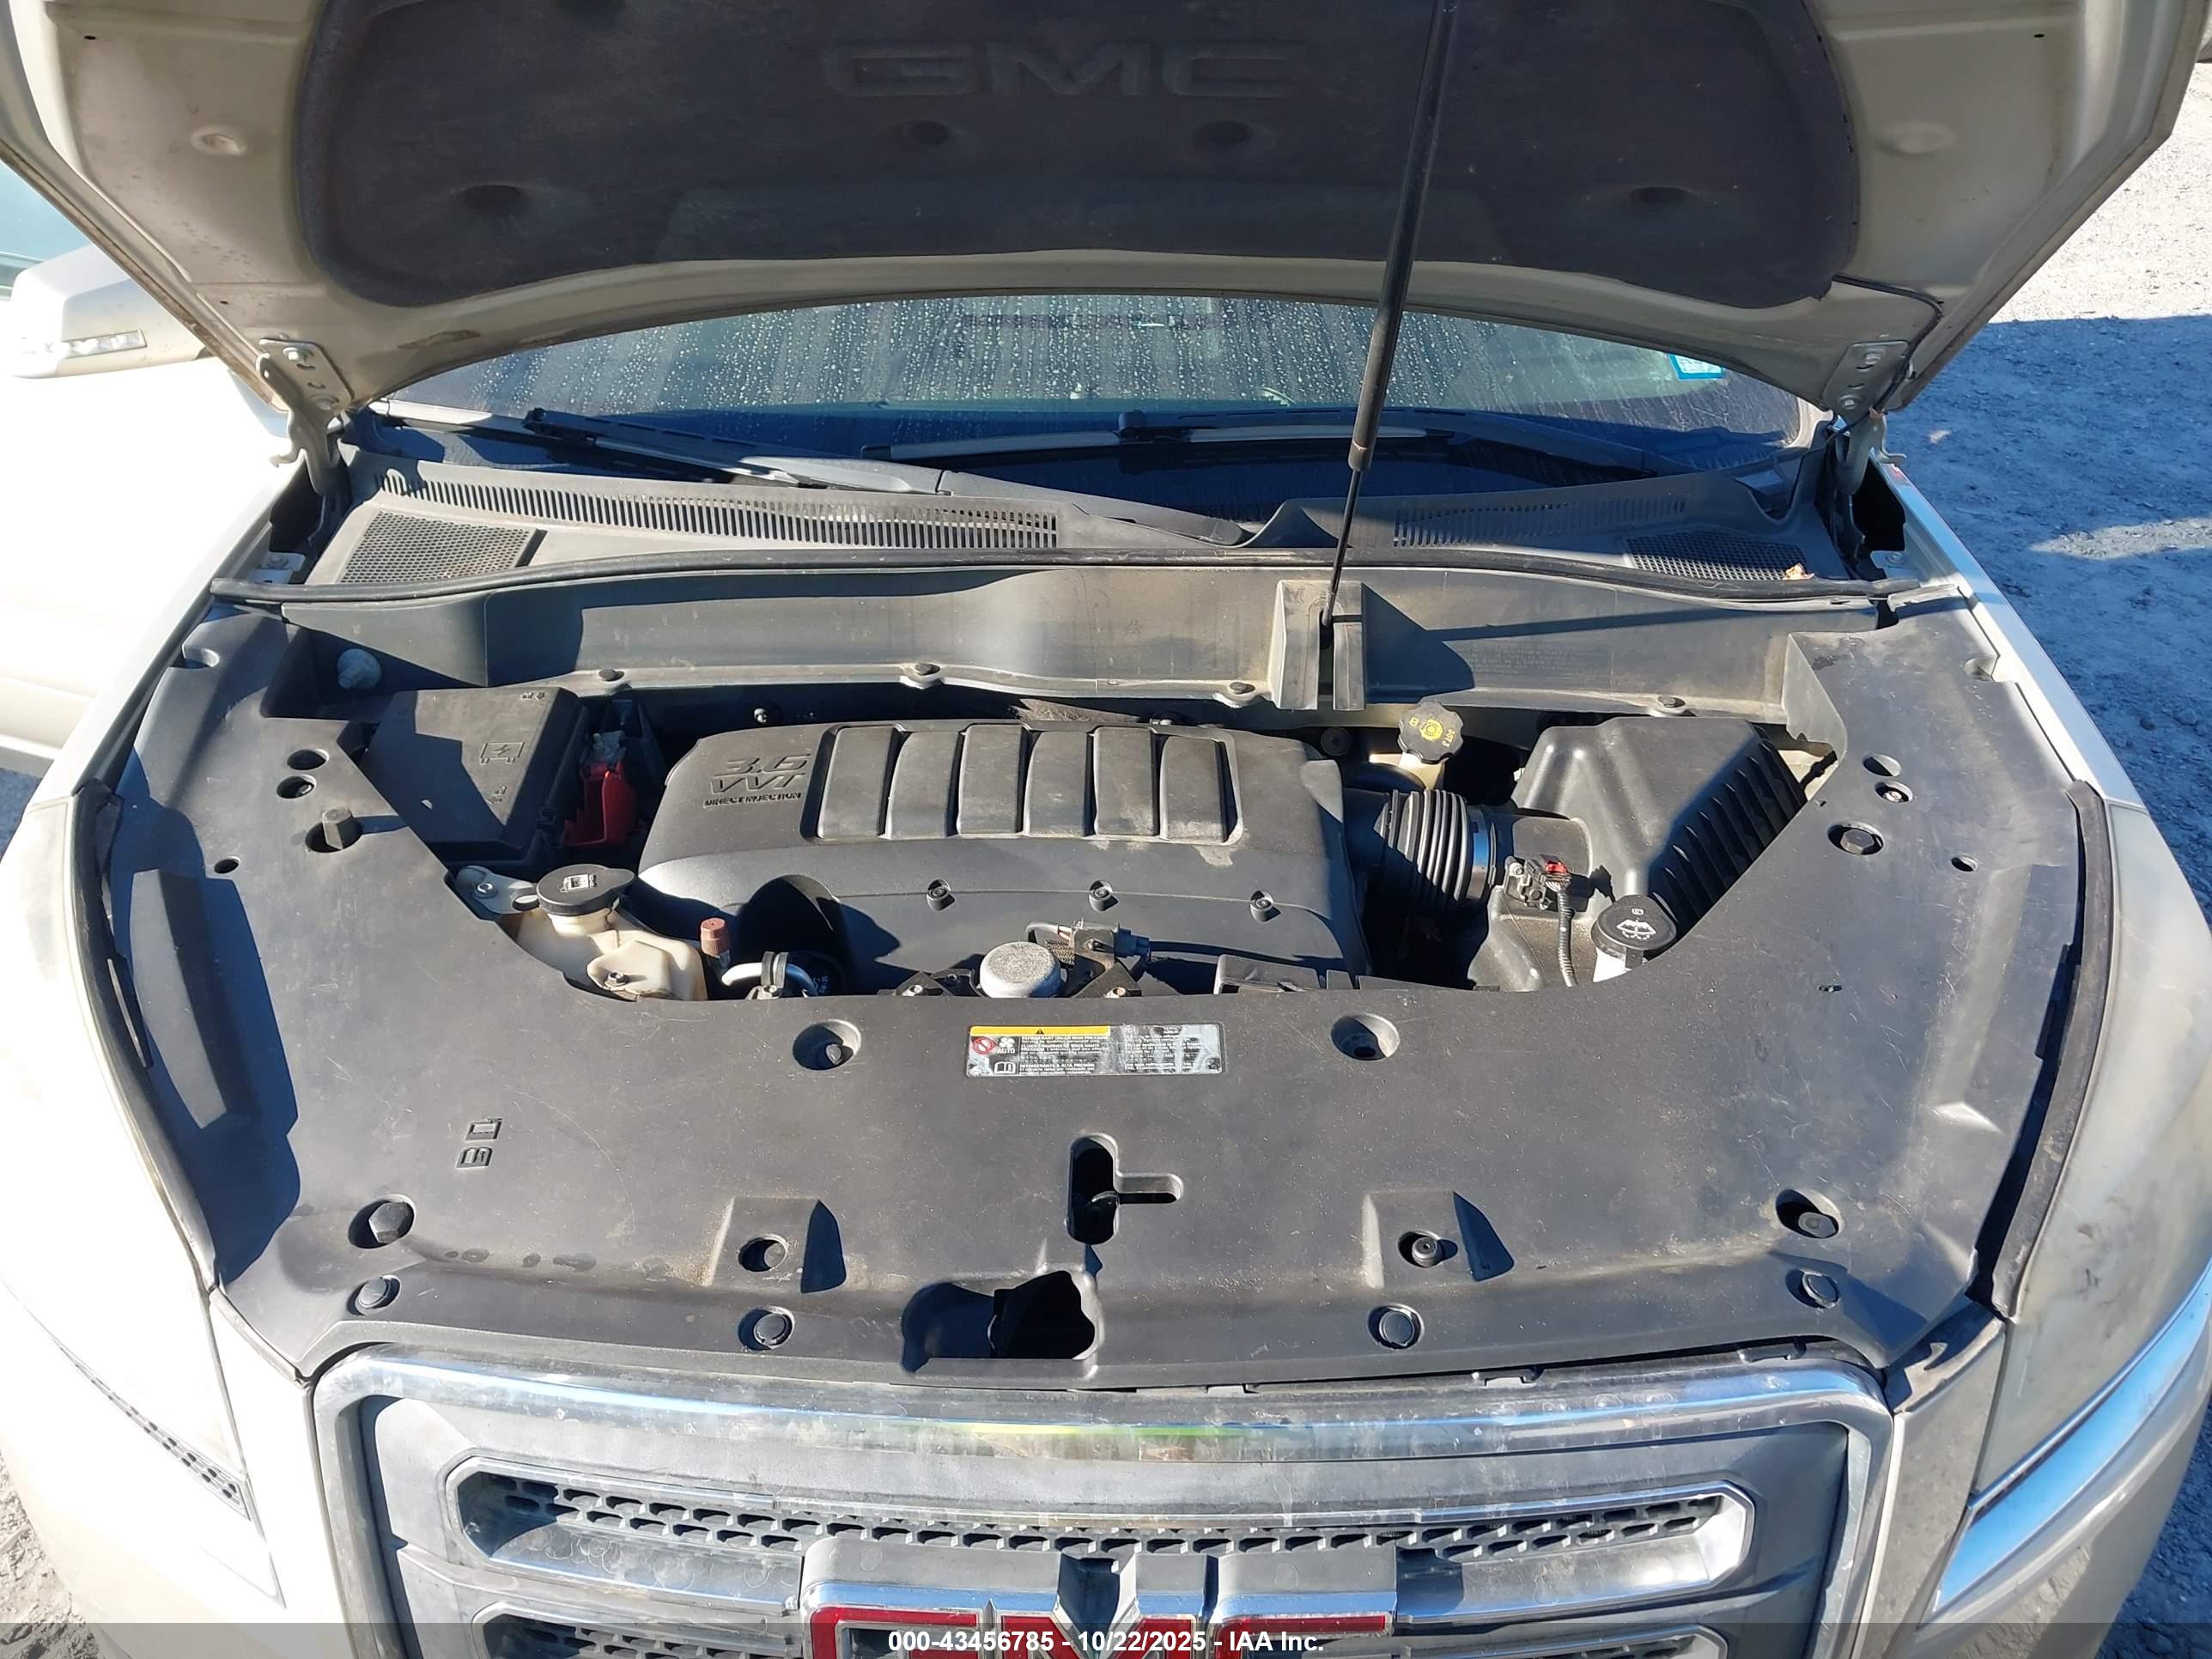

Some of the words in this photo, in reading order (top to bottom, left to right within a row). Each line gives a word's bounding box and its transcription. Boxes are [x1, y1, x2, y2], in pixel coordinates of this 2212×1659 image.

[822, 40, 1298, 98] GMC
[724, 753, 812, 775] 3.6
[711, 773, 806, 794] VVT
